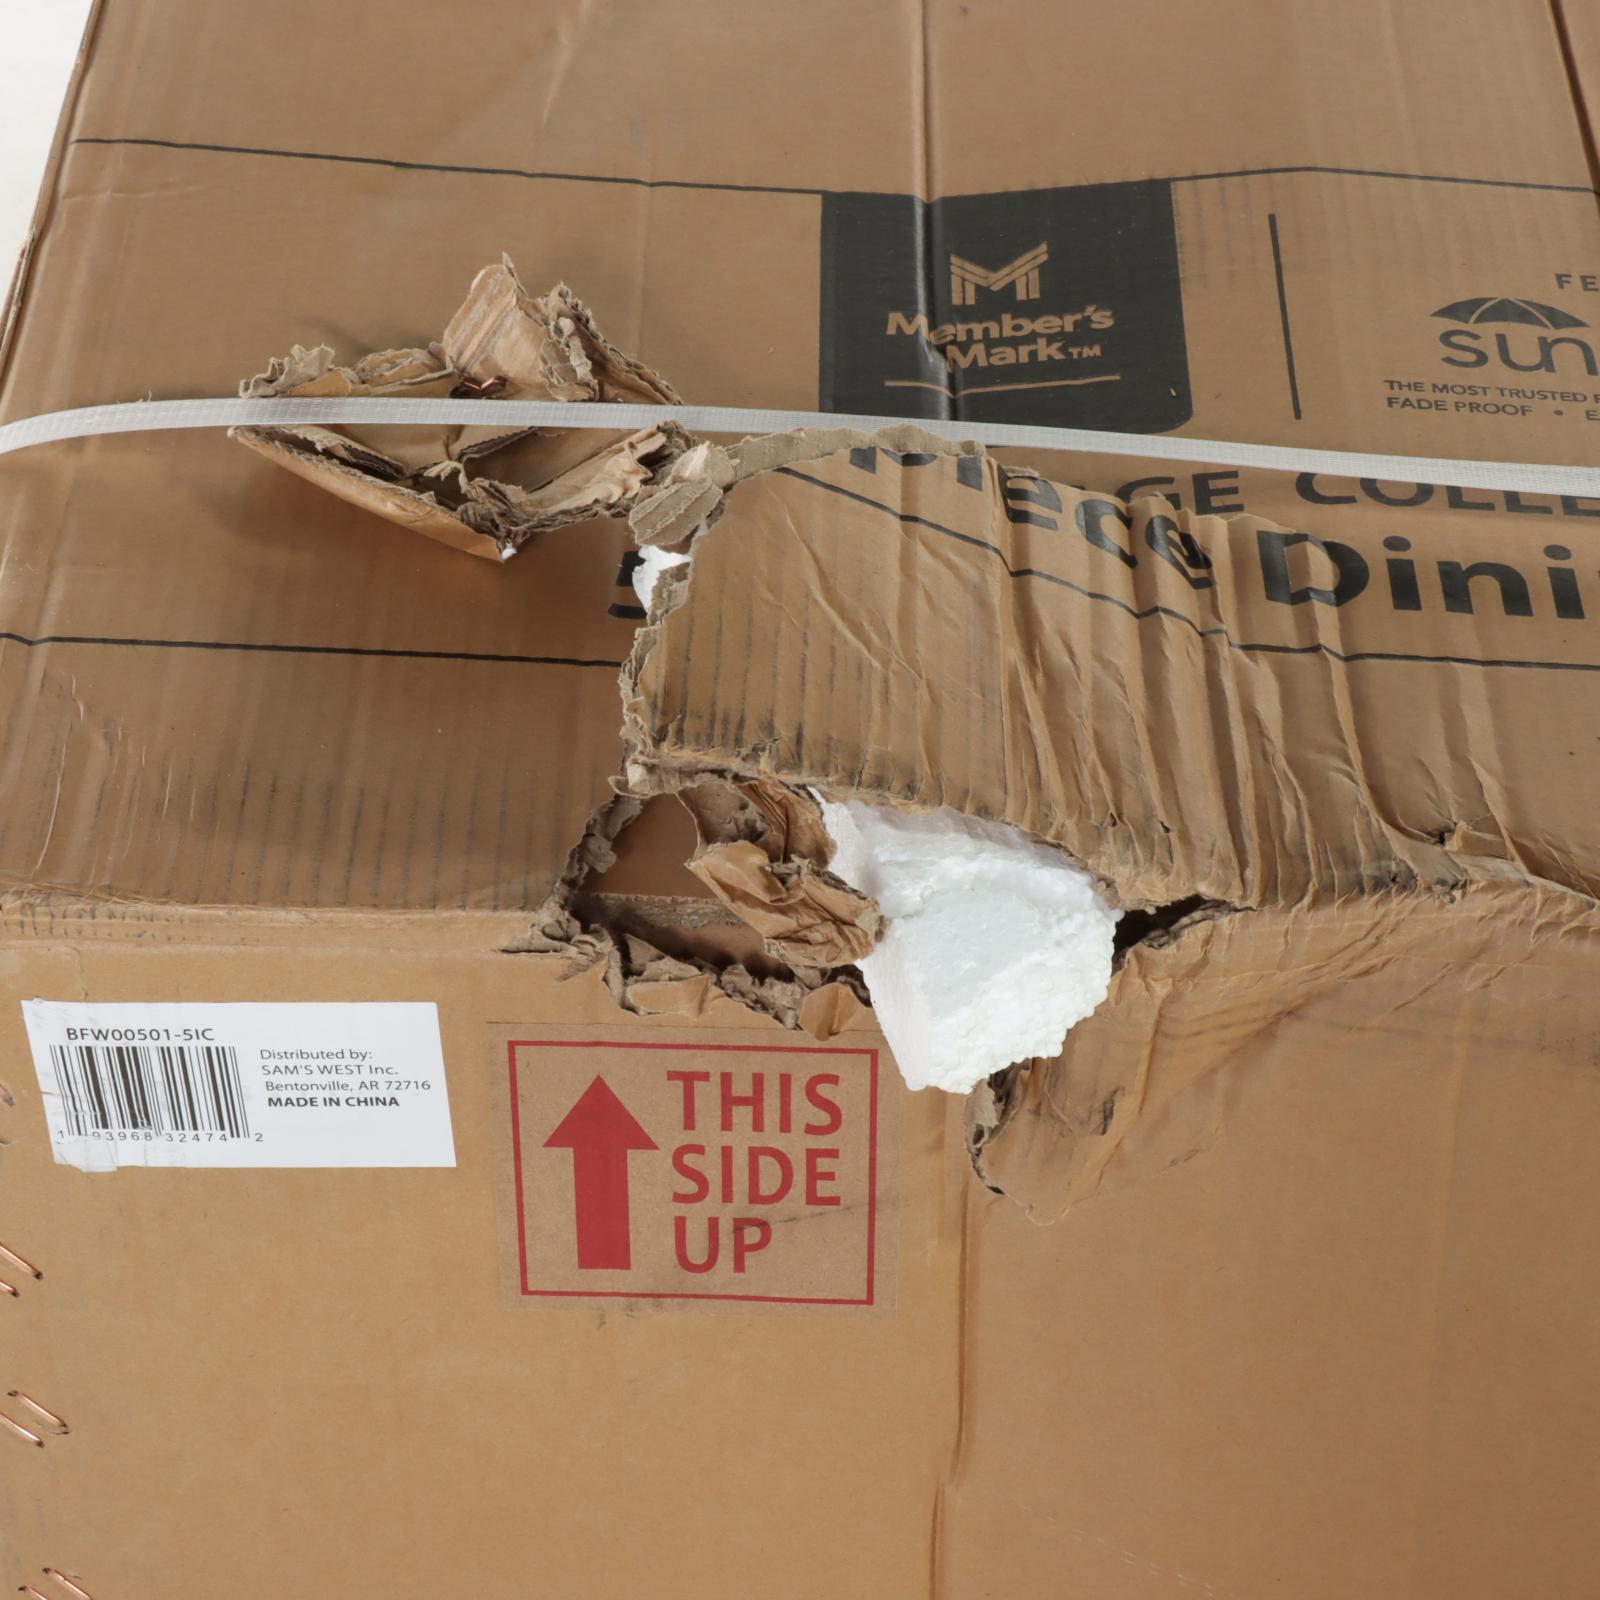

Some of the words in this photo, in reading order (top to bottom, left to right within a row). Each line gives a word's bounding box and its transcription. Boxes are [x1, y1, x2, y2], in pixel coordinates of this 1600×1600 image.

[886, 304, 1115, 345] Member's
[946, 338, 1066, 373] Mark
[1384, 380, 1425, 393] THE
[1431, 383, 1490, 396] MOST
[1495, 386, 1588, 402] TRUSTED
[1386, 397, 1449, 411] FADE
[1454, 401, 1533, 416] PROOF
[1071, 470, 1245, 516] GE
[65, 1027, 216, 1042] BFW00501-5IC
[260, 1049, 345, 1060] Distributed
[349, 1049, 373, 1063] by:
[261, 1064, 314, 1076] SAM'S
[317, 1064, 364, 1076] WEST
[368, 1064, 399, 1076] Inc.
[265, 1081, 353, 1093] Bentonville,
[358, 1081, 380, 1091] AR
[385, 1080, 431, 1092] 72716
[267, 1097, 319, 1108] MADE
[323, 1097, 341, 1107] IN
[345, 1097, 401, 1107] CHINA
[666, 1070, 843, 1136] THIS
[671, 1143, 842, 1207] SIDE
[674, 1215, 773, 1274] UP
